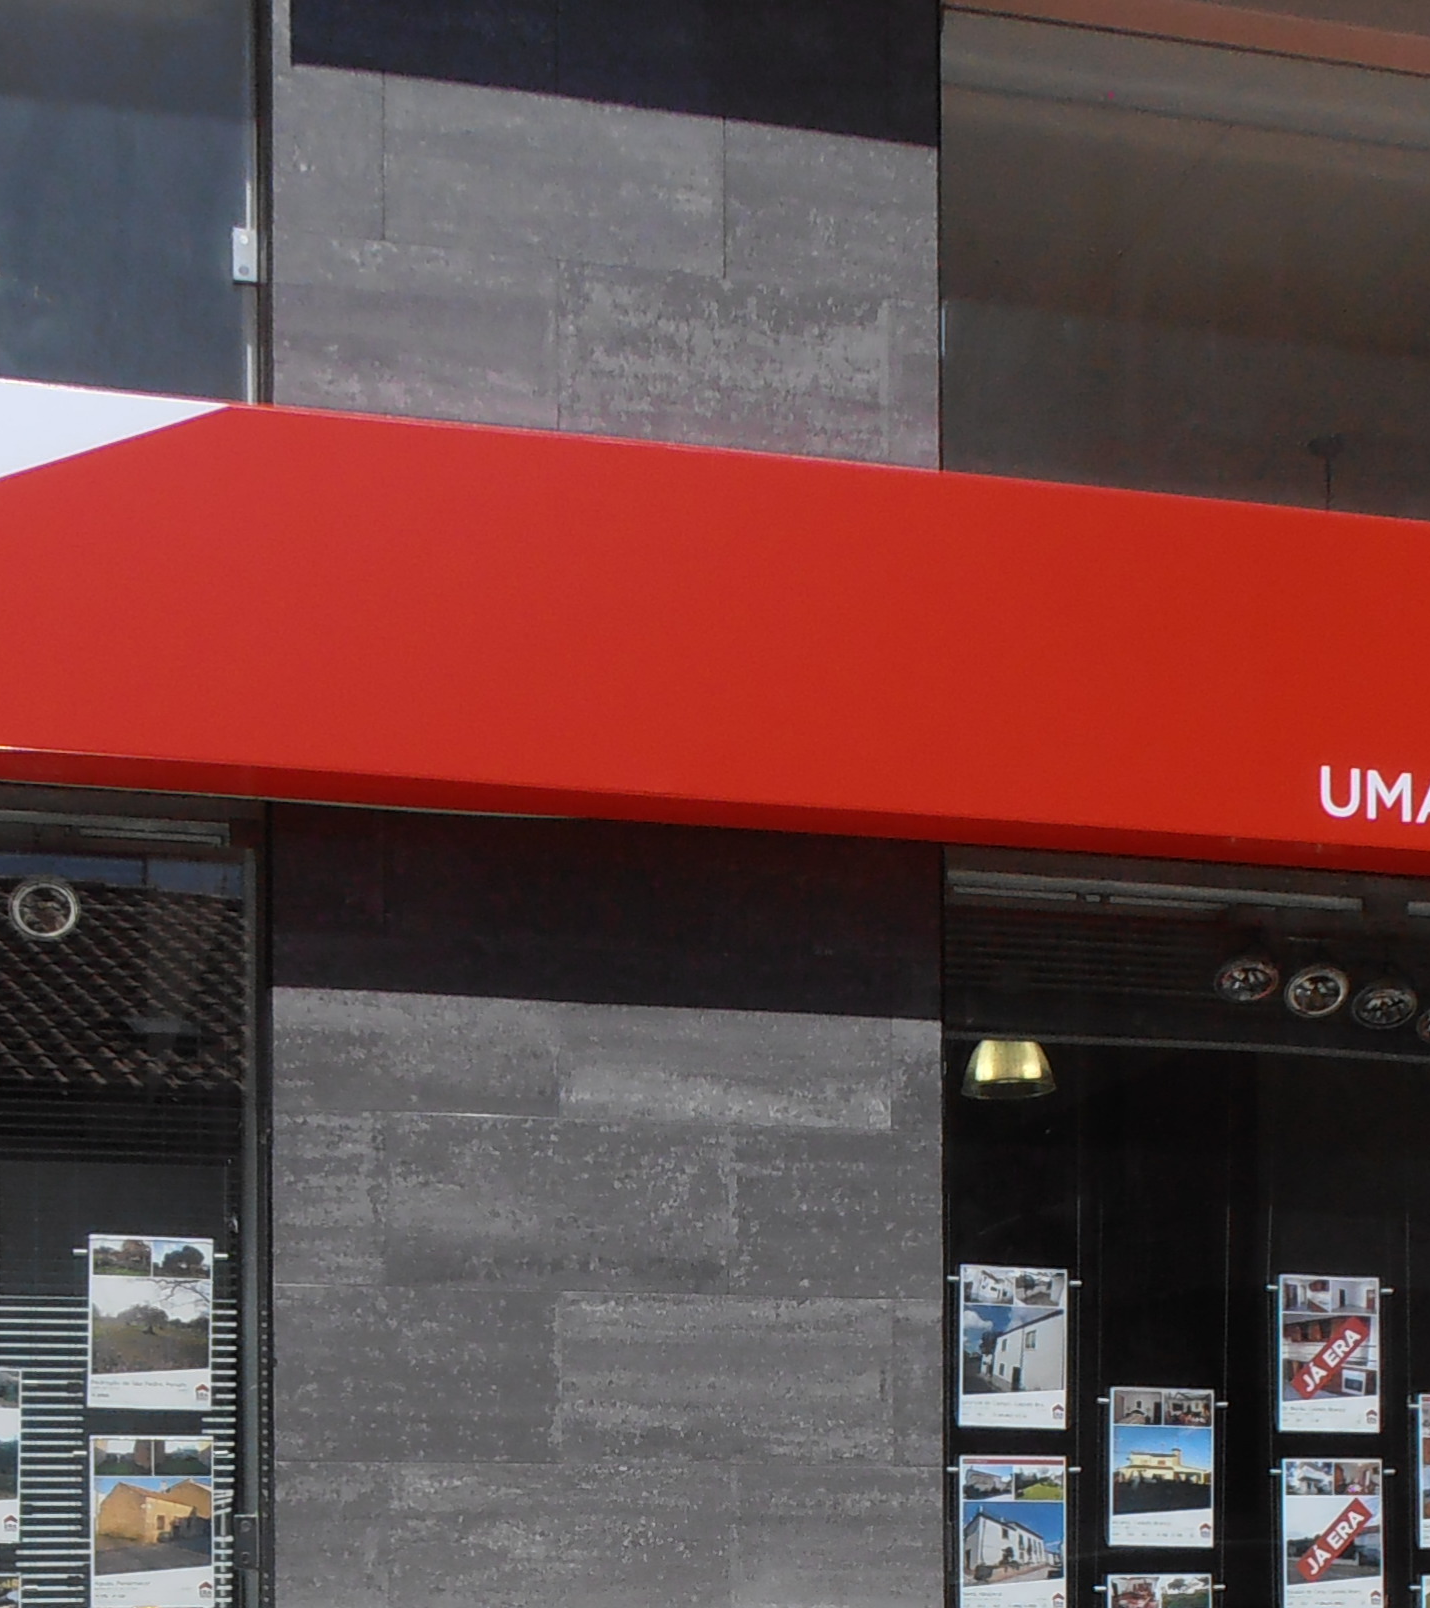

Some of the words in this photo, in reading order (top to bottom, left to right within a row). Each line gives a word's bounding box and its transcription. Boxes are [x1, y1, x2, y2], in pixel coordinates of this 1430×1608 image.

[1302, 1361, 1328, 1392] JÁ
[1322, 1329, 1362, 1368] ERA
[1307, 1544, 1332, 1575] JÁ
[1326, 1511, 1365, 1550] ERA
